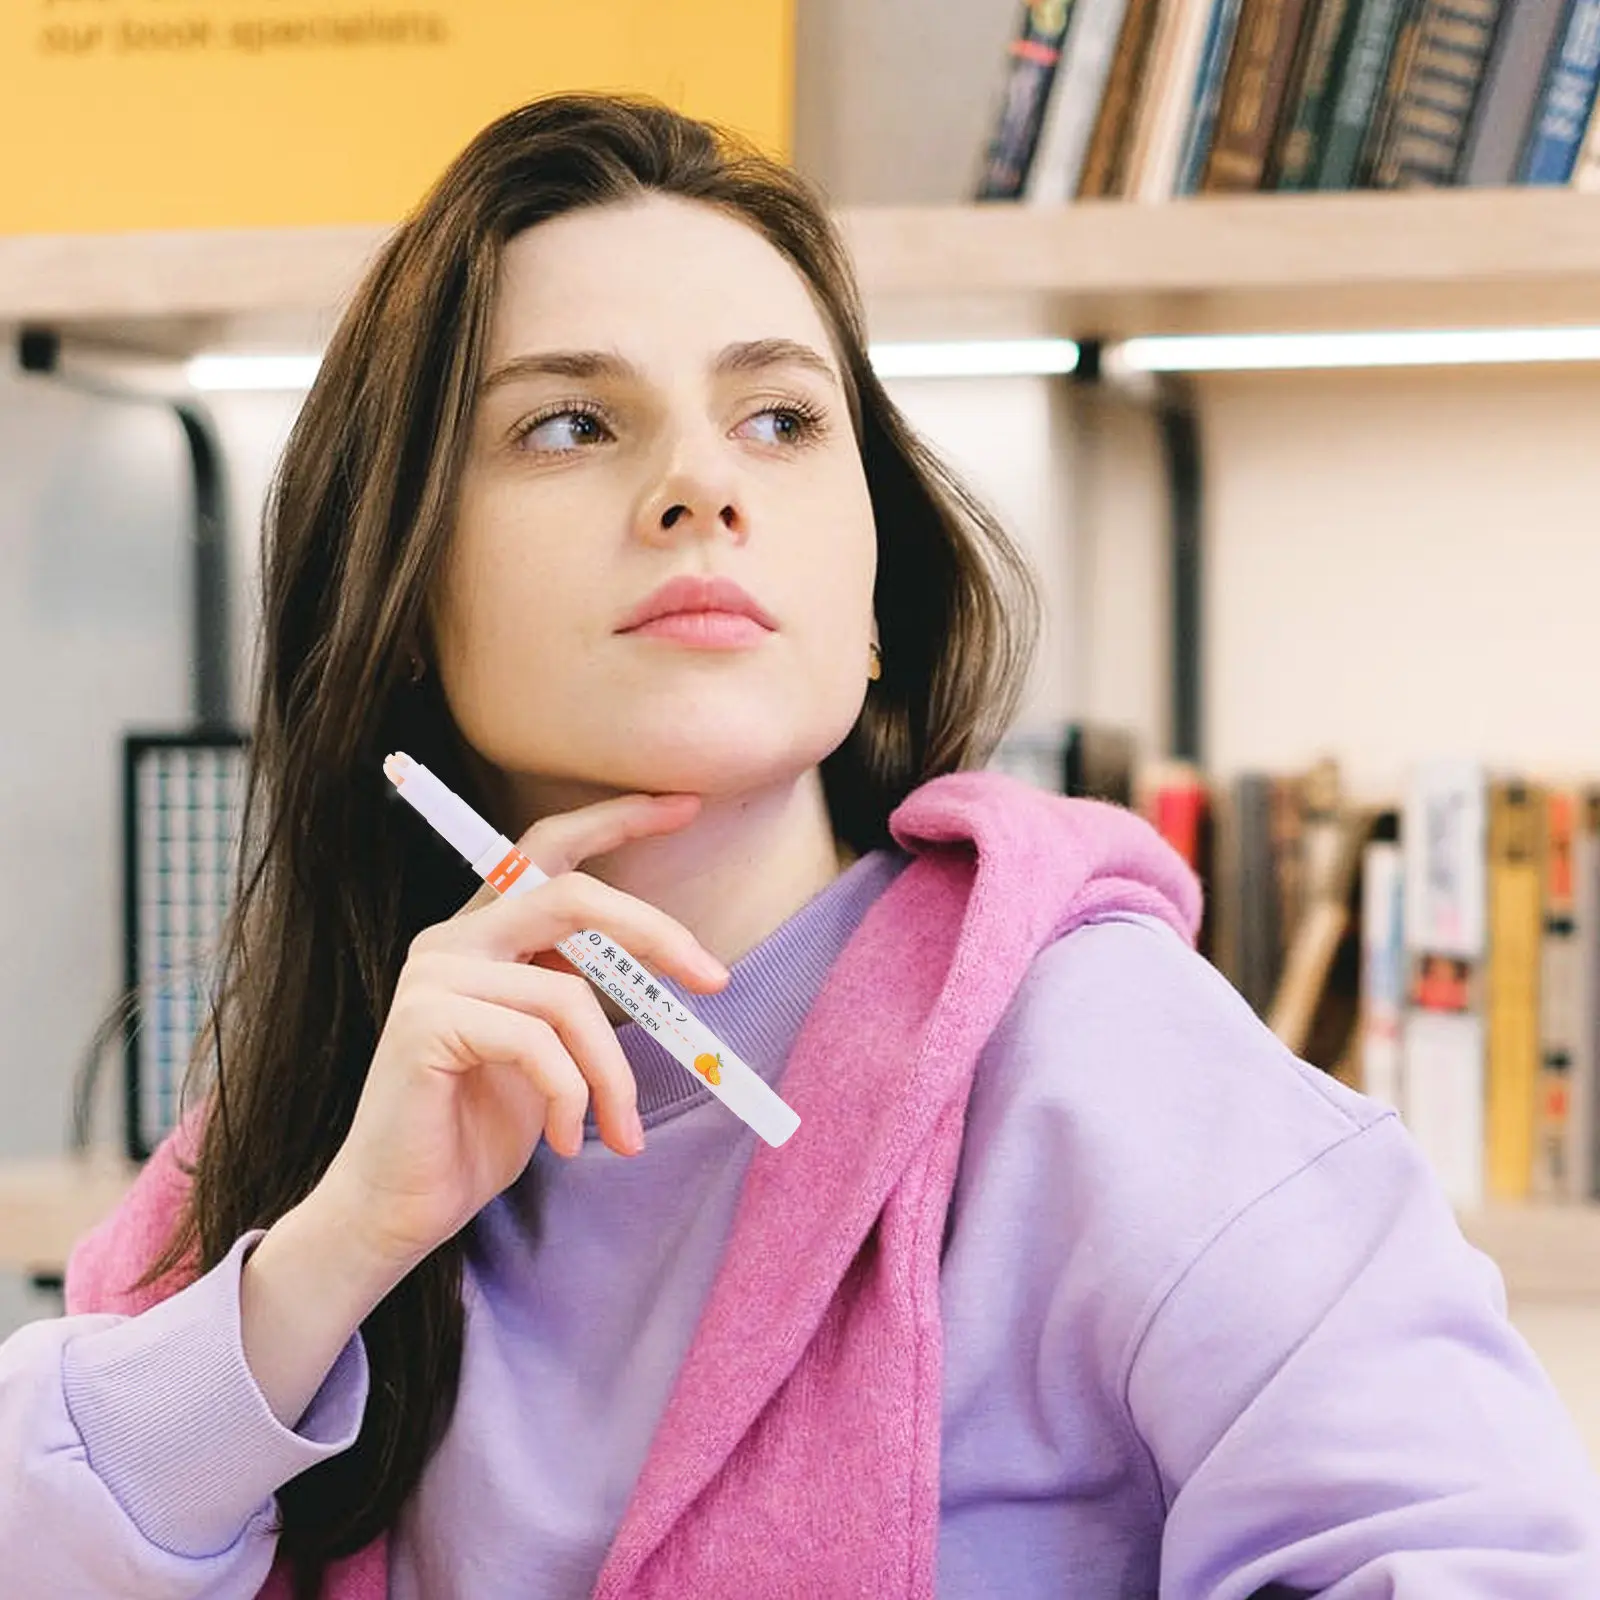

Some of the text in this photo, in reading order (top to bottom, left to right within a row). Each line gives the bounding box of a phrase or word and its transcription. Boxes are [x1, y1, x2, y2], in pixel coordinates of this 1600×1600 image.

[585, 961, 607, 982] LINE
[608, 982, 640, 1012] COLOR
[641, 1012, 661, 1031] PEN
